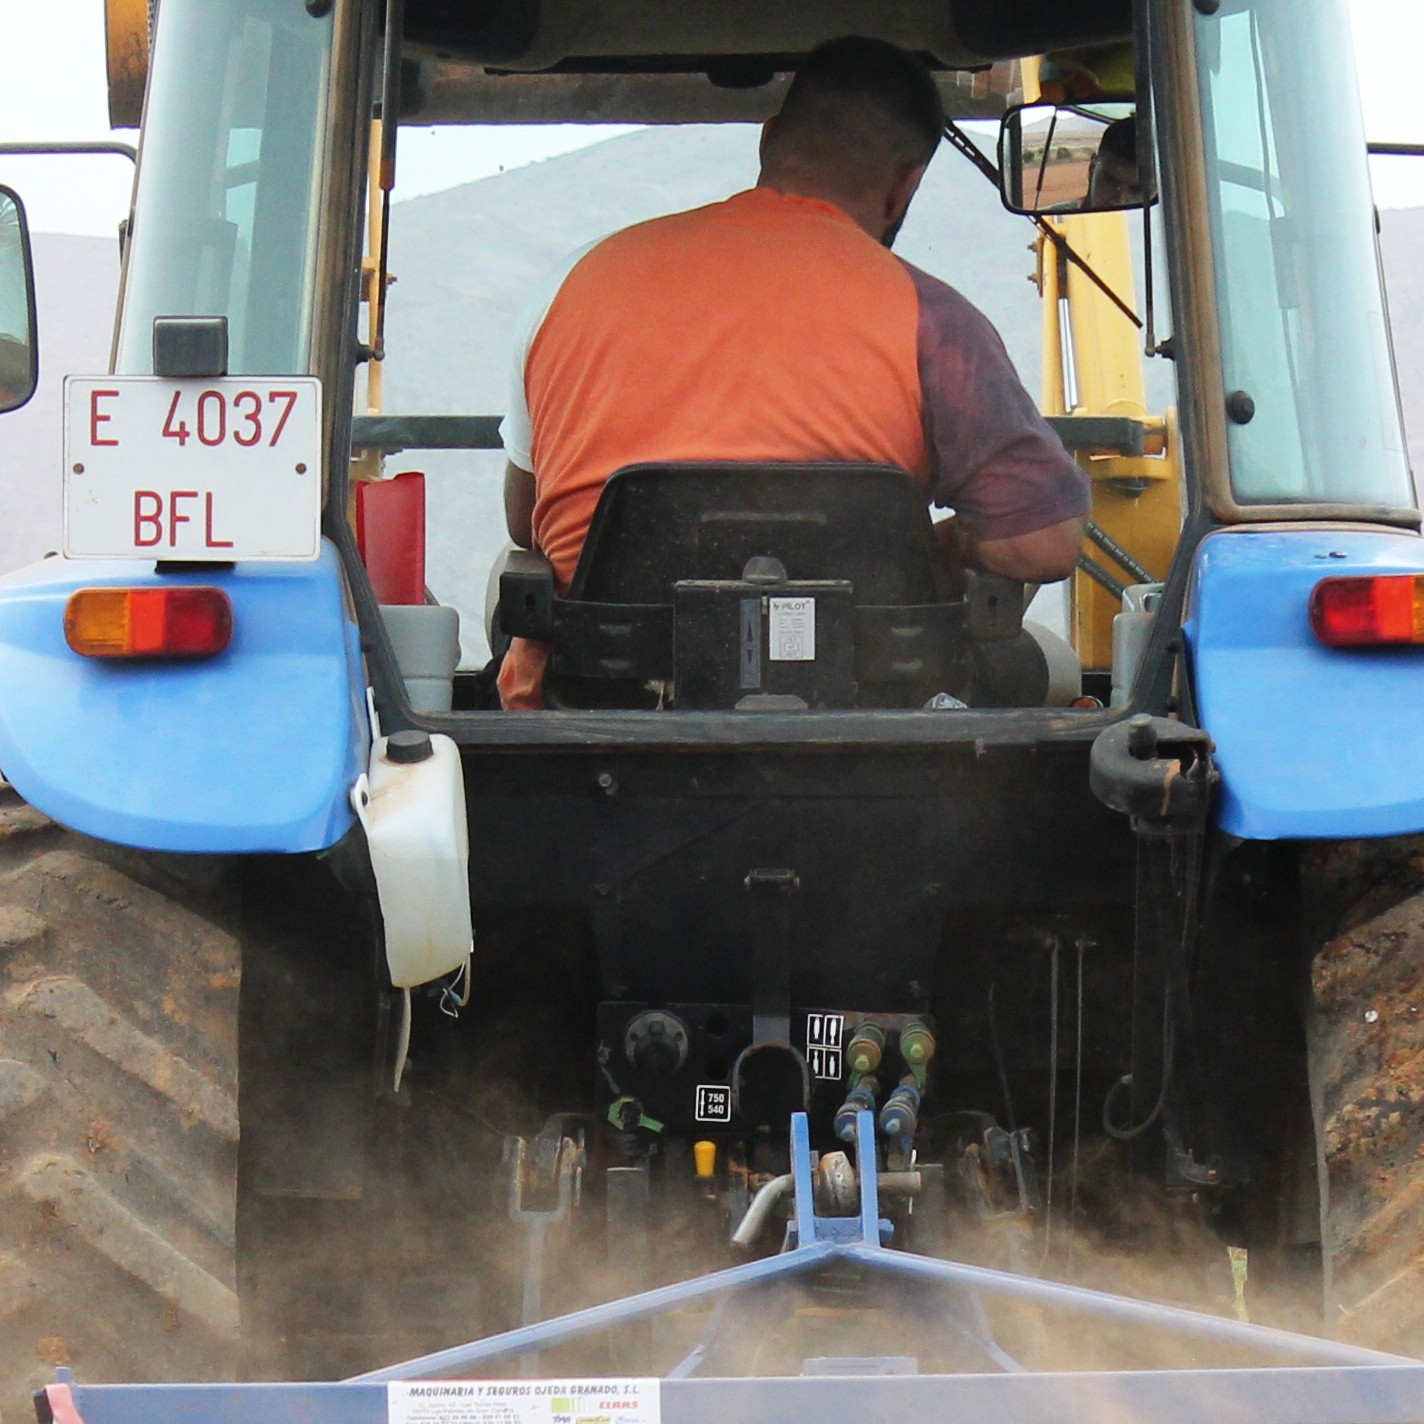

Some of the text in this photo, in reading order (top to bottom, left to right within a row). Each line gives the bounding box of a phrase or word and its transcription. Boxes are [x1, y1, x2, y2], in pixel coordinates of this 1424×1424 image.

[91, 390, 297, 447] E 4037
[134, 490, 234, 547] BFL
[708, 1093, 725, 1103] 750
[708, 1104, 725, 1115] 540
[409, 1386, 474, 1397] MAQUINARIA
[477, 1386, 484, 1396] Y
[486, 1386, 531, 1396] SEGUROS
[534, 1386, 567, 1395] OJEDA
[570, 1385, 620, 1396] GRANADO,
